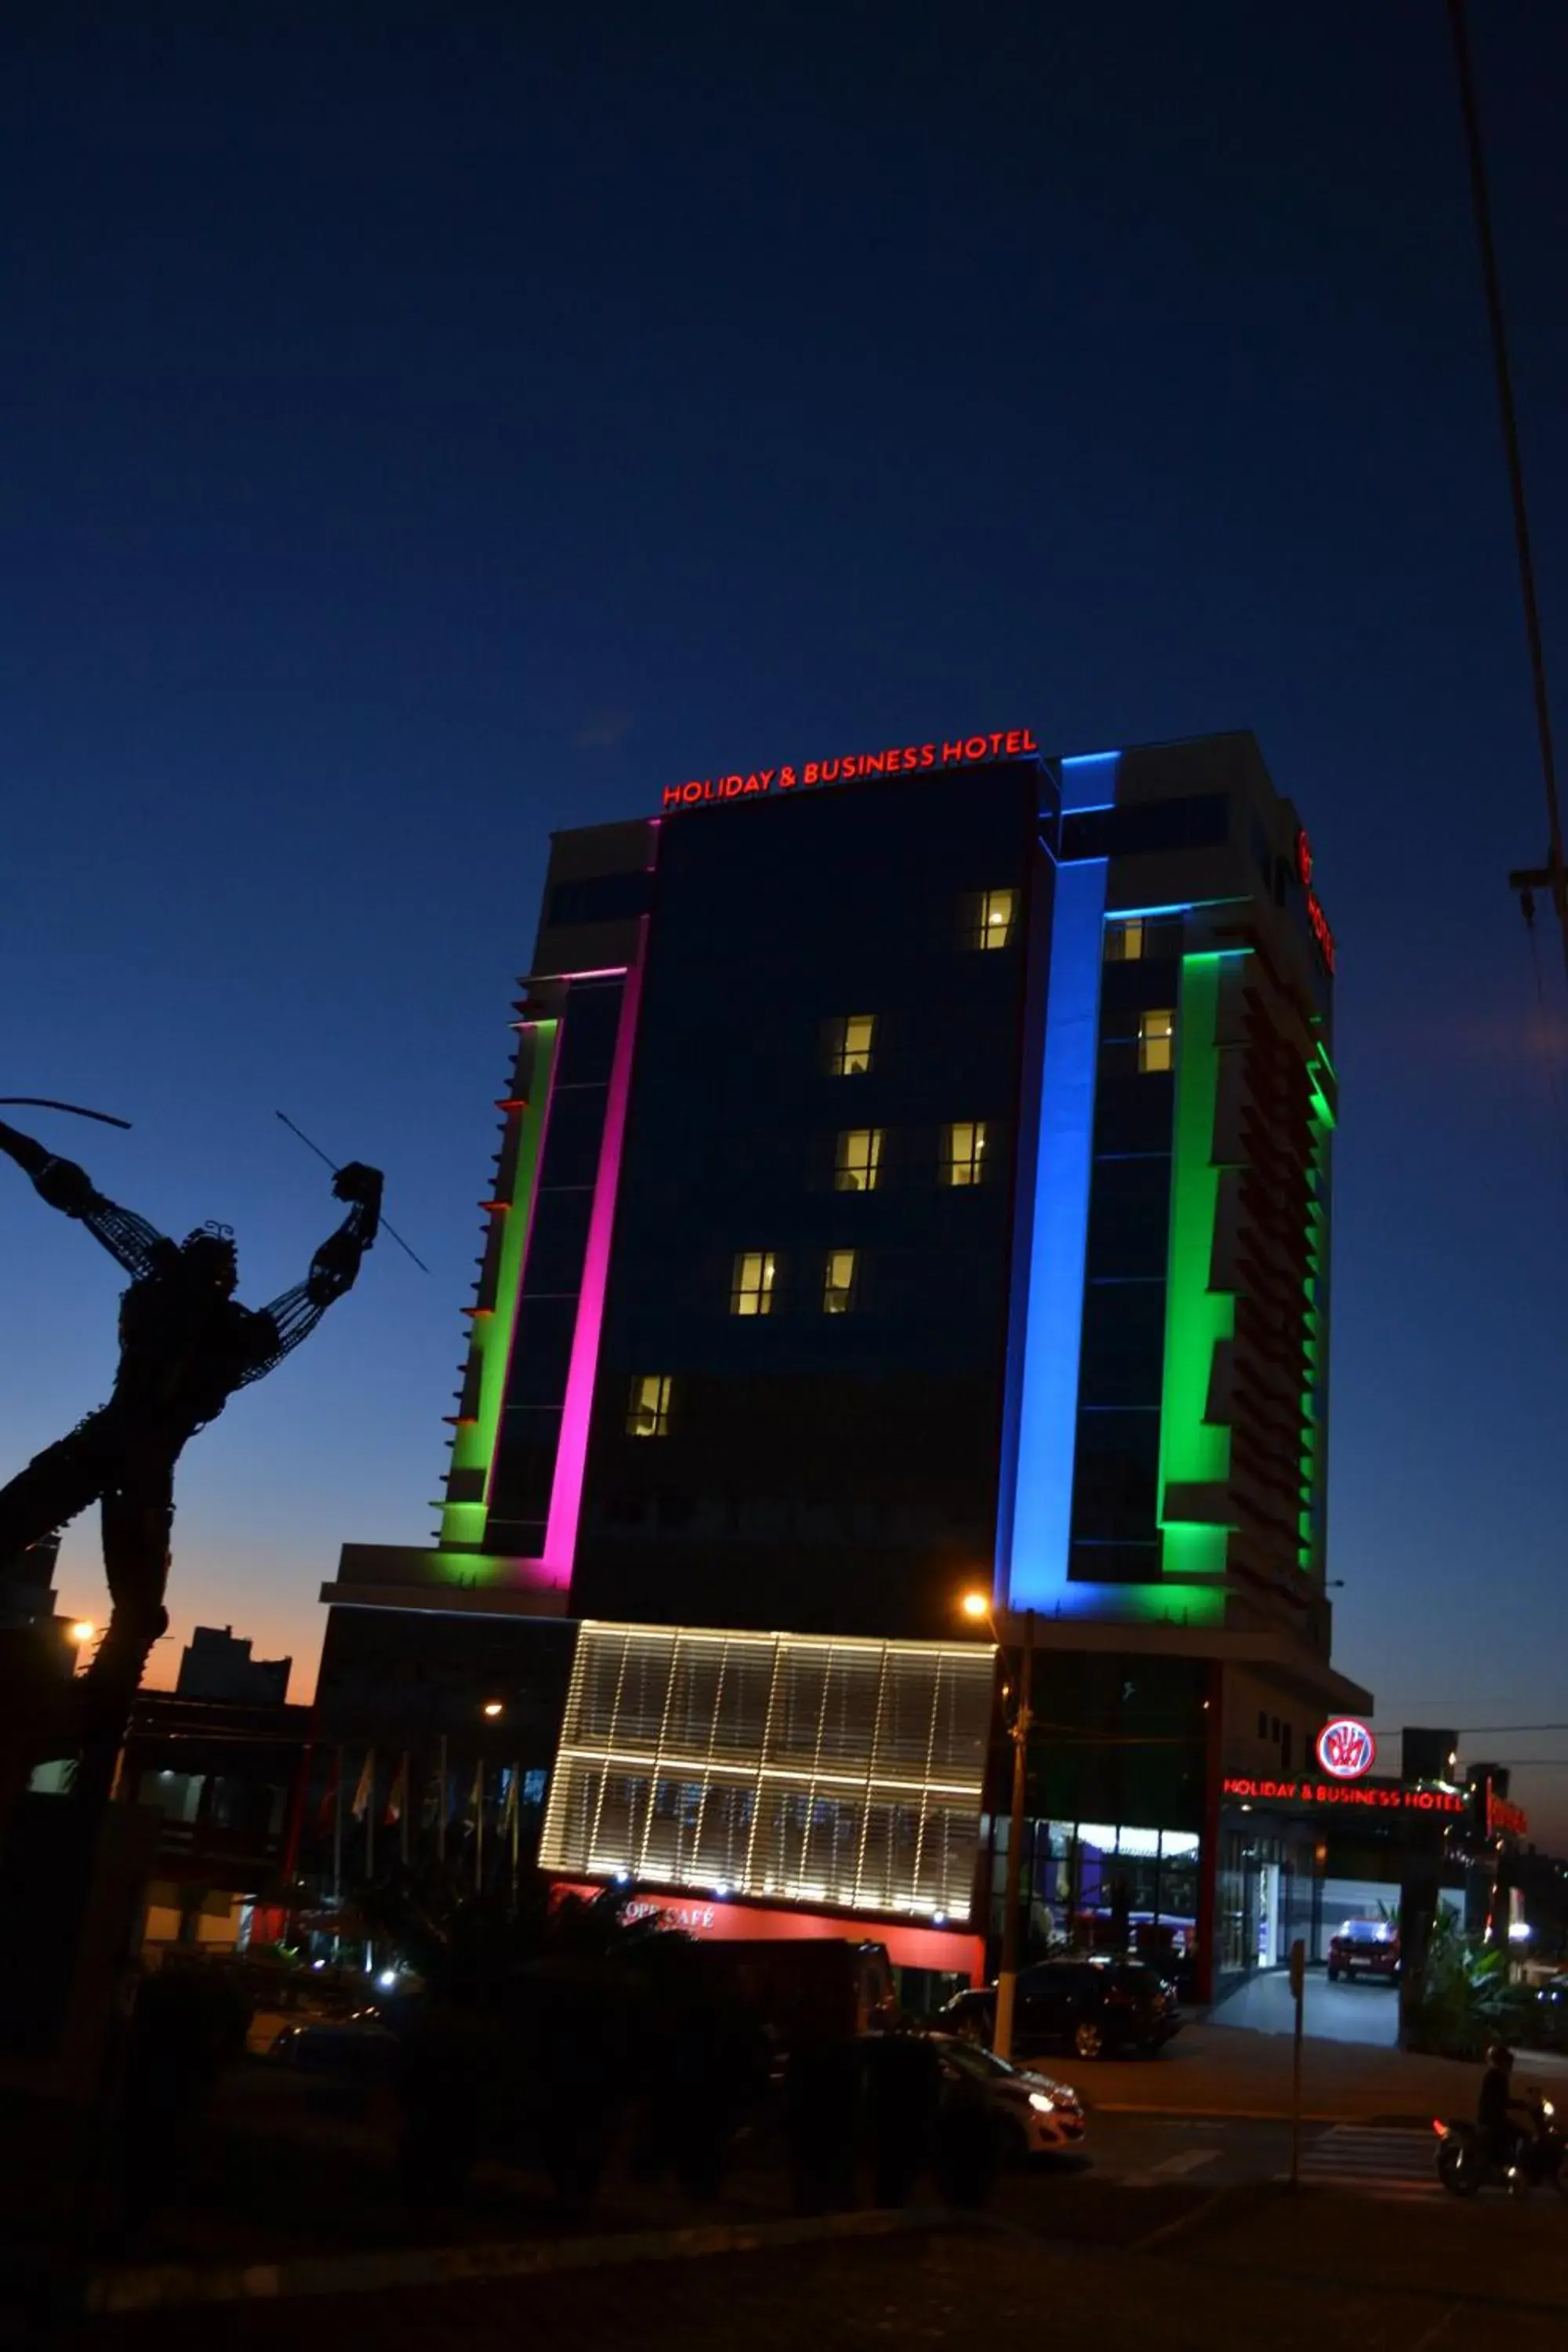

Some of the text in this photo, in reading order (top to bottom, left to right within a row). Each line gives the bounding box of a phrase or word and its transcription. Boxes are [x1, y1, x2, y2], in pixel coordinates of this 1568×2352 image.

[663, 730, 1038, 804] HOLIDAY & BUSINESS HOTEL
[1222, 1777, 1297, 1798] HOLIDAY
[1316, 1784, 1401, 1808] BUSINESS
[1403, 1790, 1465, 1813] HOTEL
